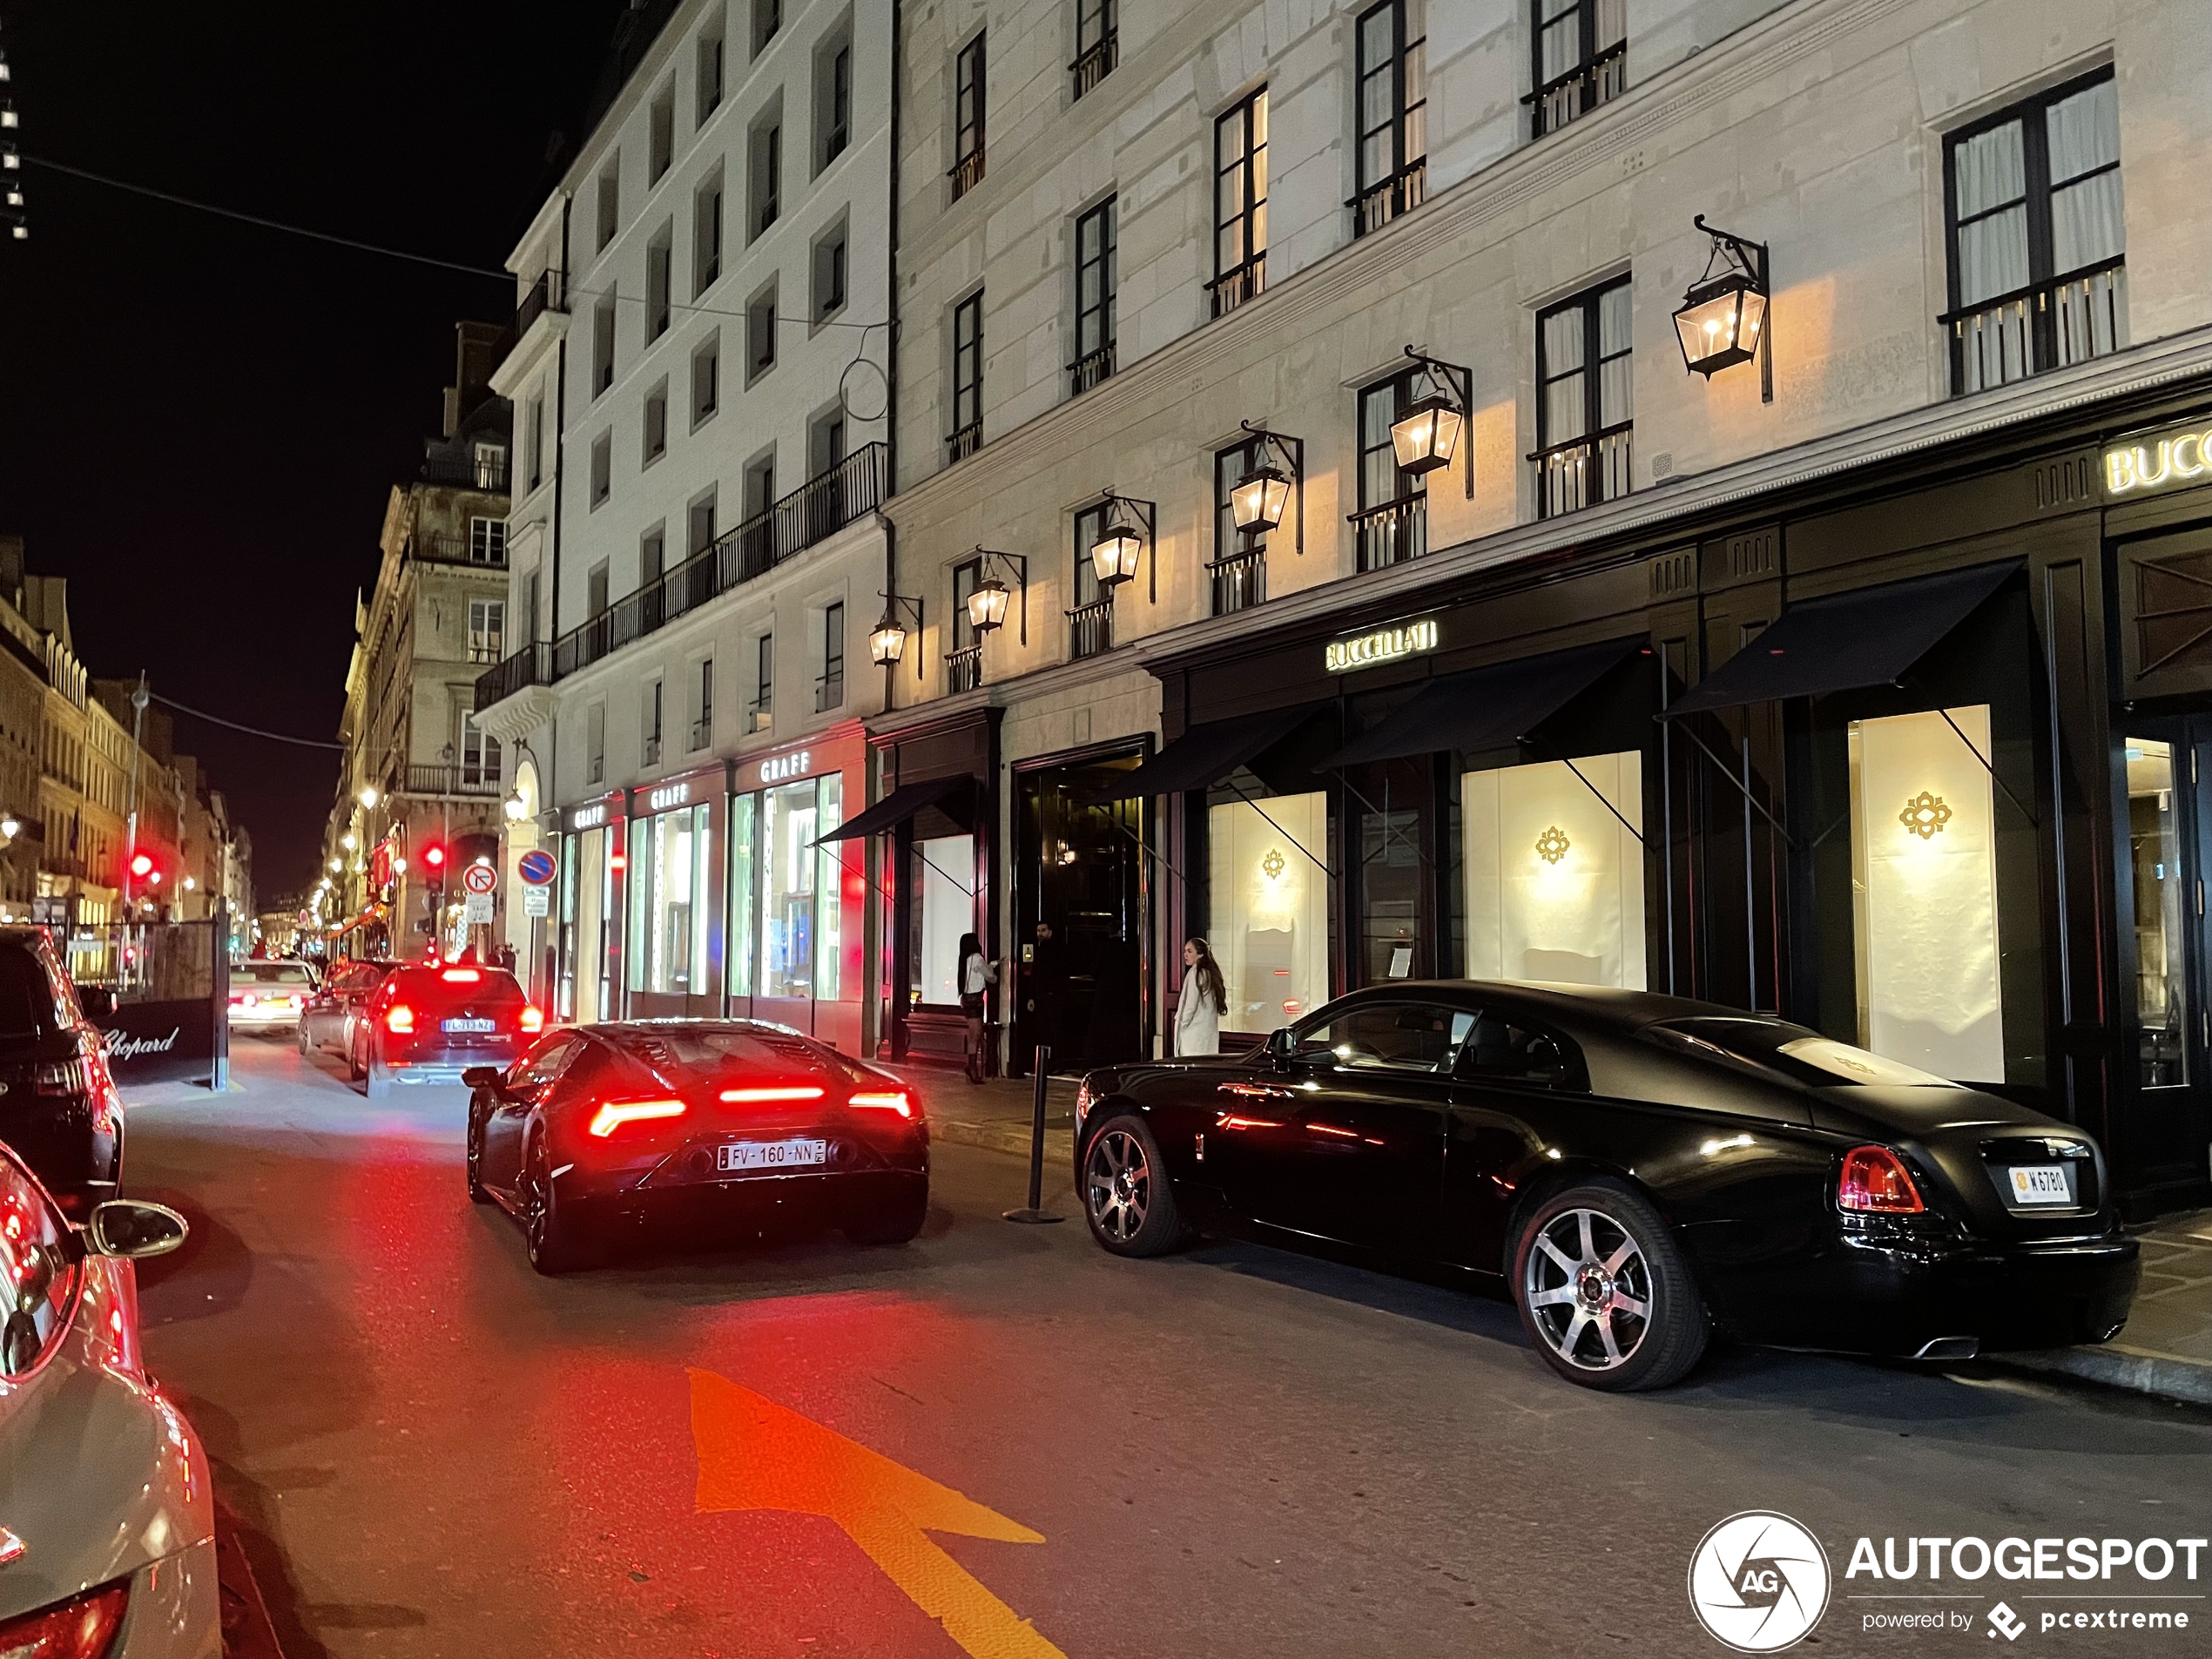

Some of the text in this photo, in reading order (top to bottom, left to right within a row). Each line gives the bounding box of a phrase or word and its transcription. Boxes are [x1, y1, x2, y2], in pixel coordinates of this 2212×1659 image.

[1325, 621, 1438, 671] BUCCELLATI
[760, 752, 810, 783] GRAFF
[651, 784, 689, 810] GRAFF
[575, 805, 604, 828] GRAFF
[104, 1027, 179, 1061] Chopard
